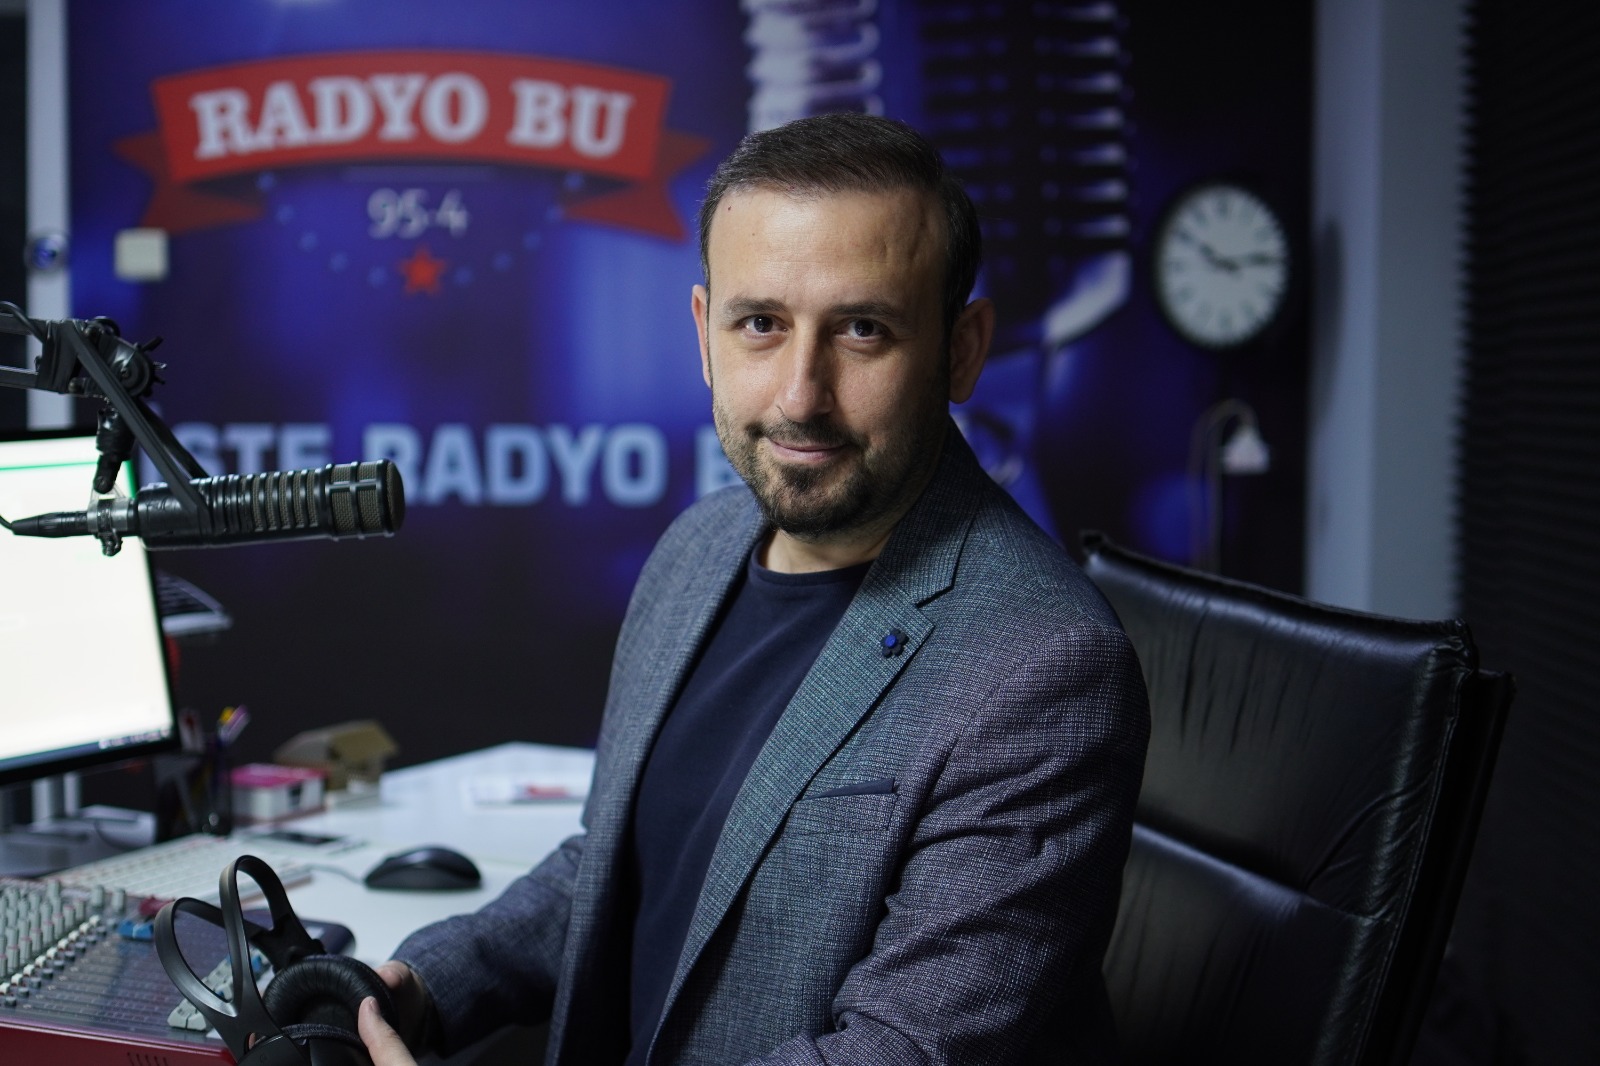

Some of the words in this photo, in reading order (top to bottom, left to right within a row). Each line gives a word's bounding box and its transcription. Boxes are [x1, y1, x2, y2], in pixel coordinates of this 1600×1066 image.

[191, 72, 490, 160] RADYO
[508, 78, 634, 158] BU
[365, 423, 667, 505] RADYO
